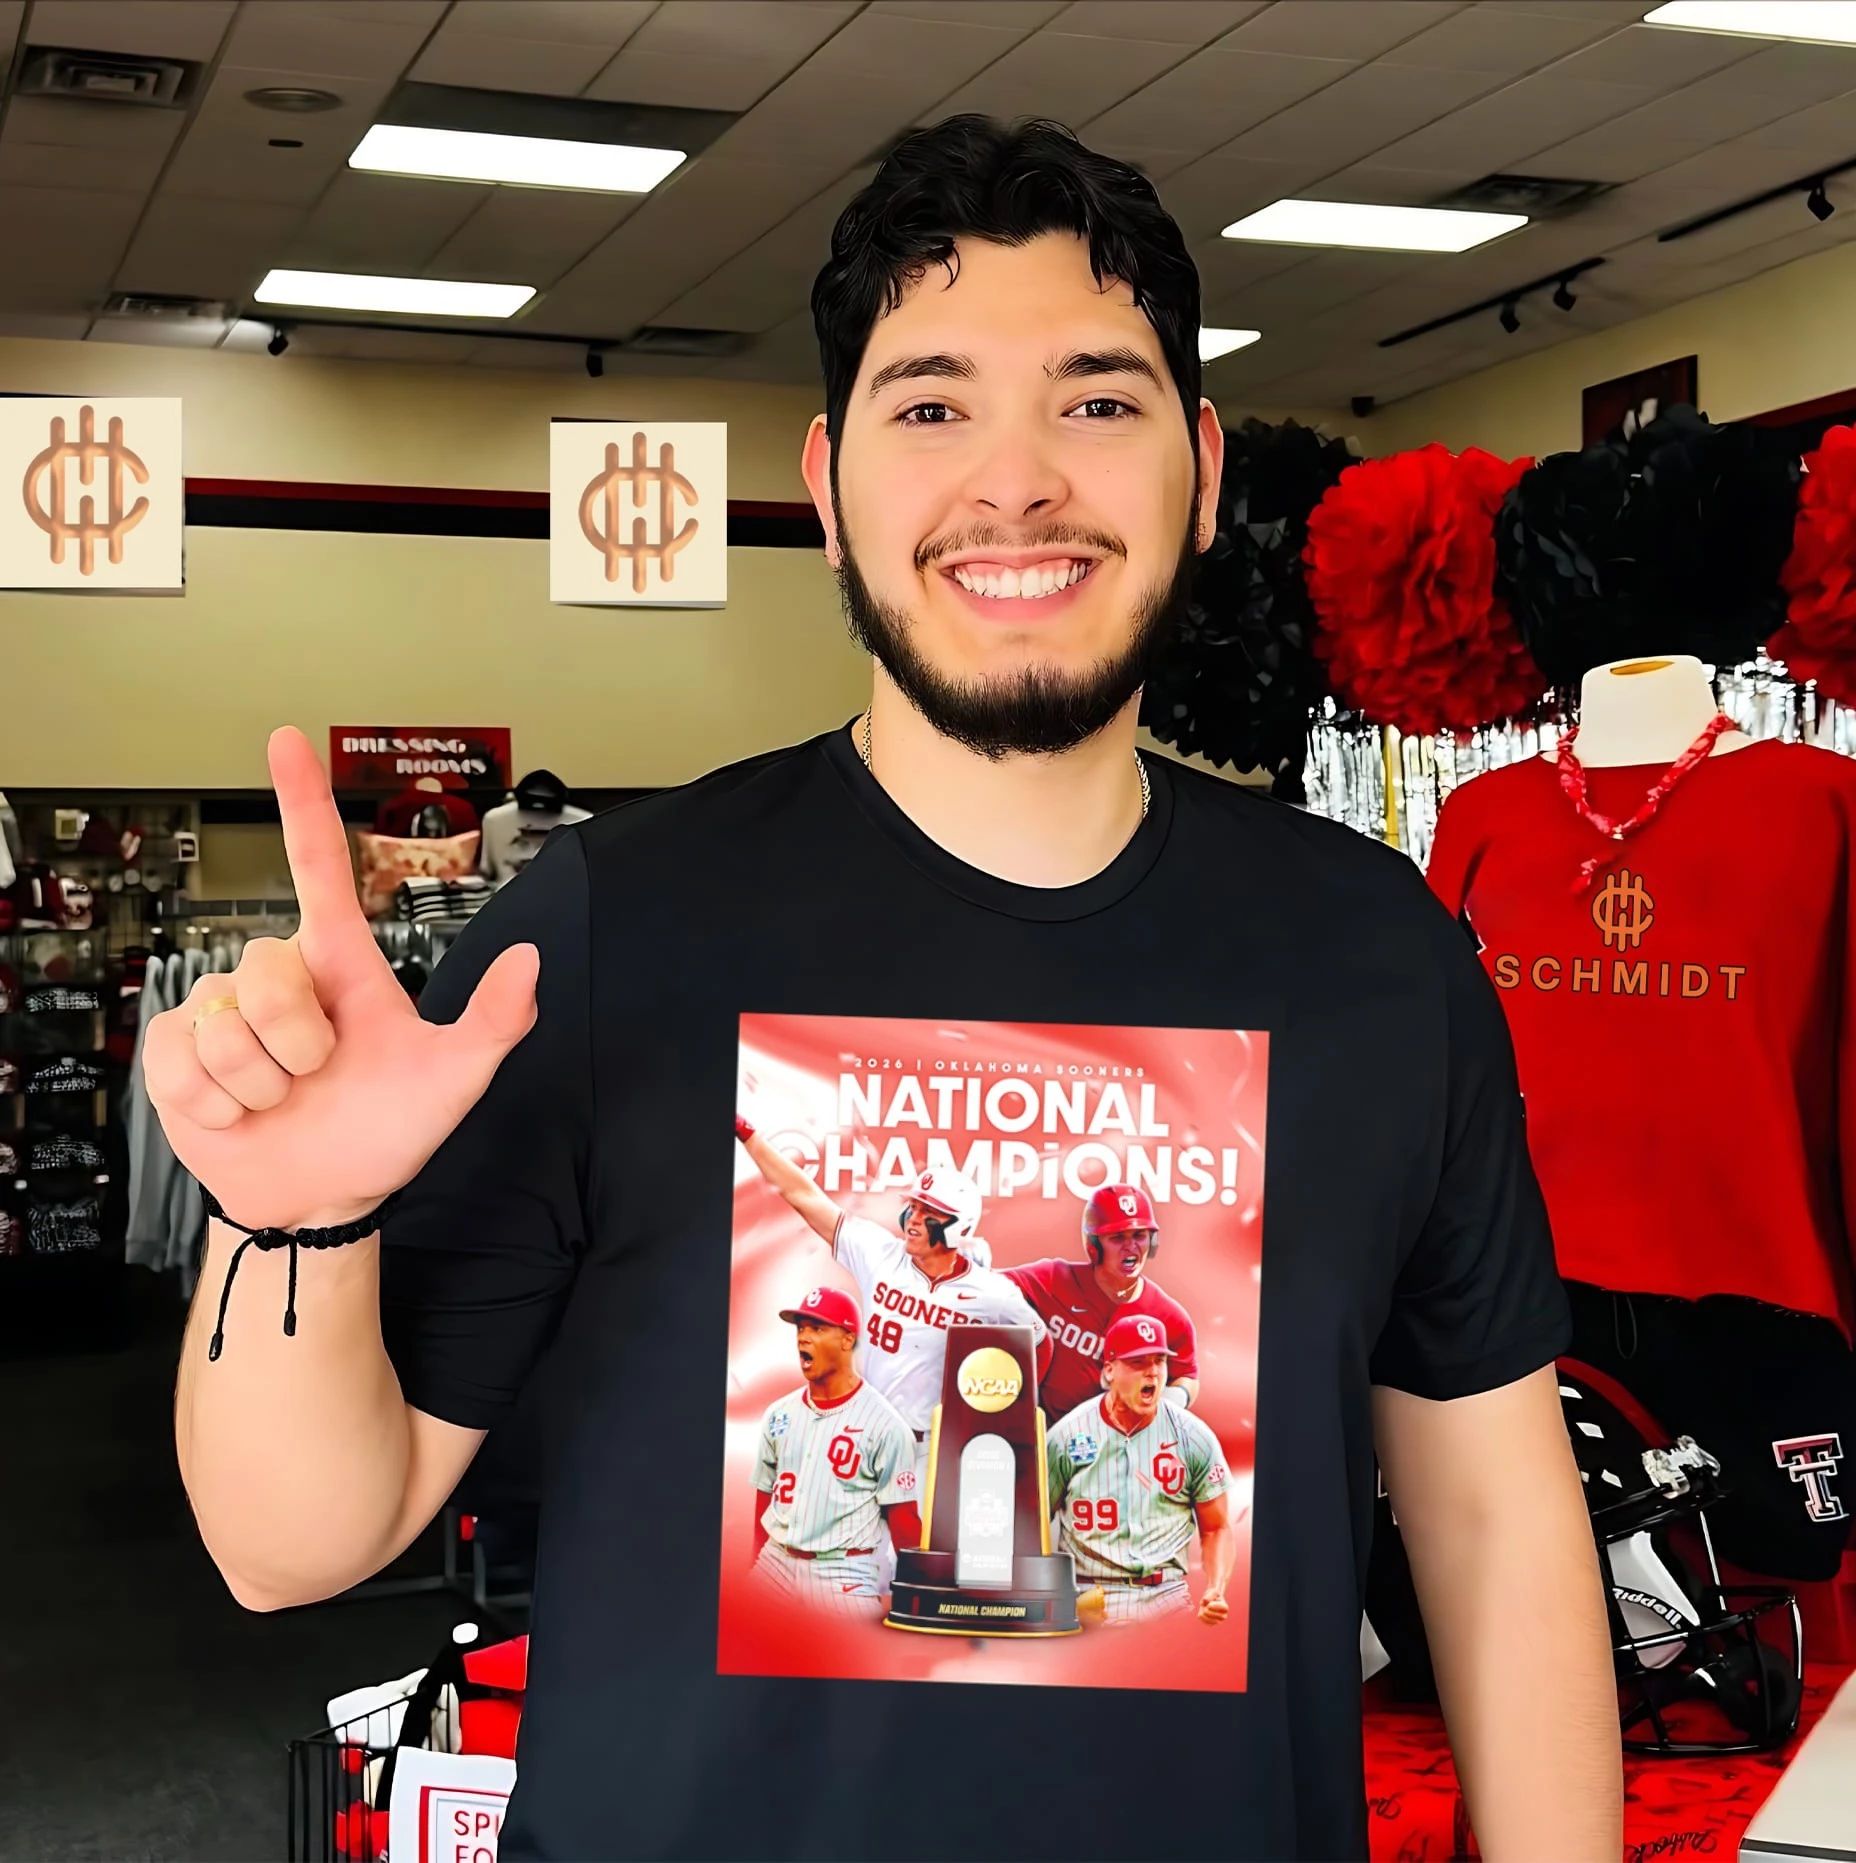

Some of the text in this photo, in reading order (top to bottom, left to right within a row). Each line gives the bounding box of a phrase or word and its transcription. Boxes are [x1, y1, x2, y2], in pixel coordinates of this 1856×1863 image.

[396, 758, 488, 775] ROOMS
[1494, 954, 1746, 999] SCHMIDT
[854, 1057, 903, 1070] 2026
[935, 1060, 1043, 1074] OKLAHOMA
[1056, 1064, 1145, 1078] SOONERS
[838, 1072, 1170, 1138] NATIONAL
[867, 1312, 904, 1354] 48
[963, 1376, 1020, 1398] NCAA
[827, 1434, 863, 1480] OU
[1152, 1451, 1186, 1496] OU
[1072, 1498, 1119, 1532] 99
[938, 1603, 1026, 1618] NATIONAL CHAMPION
